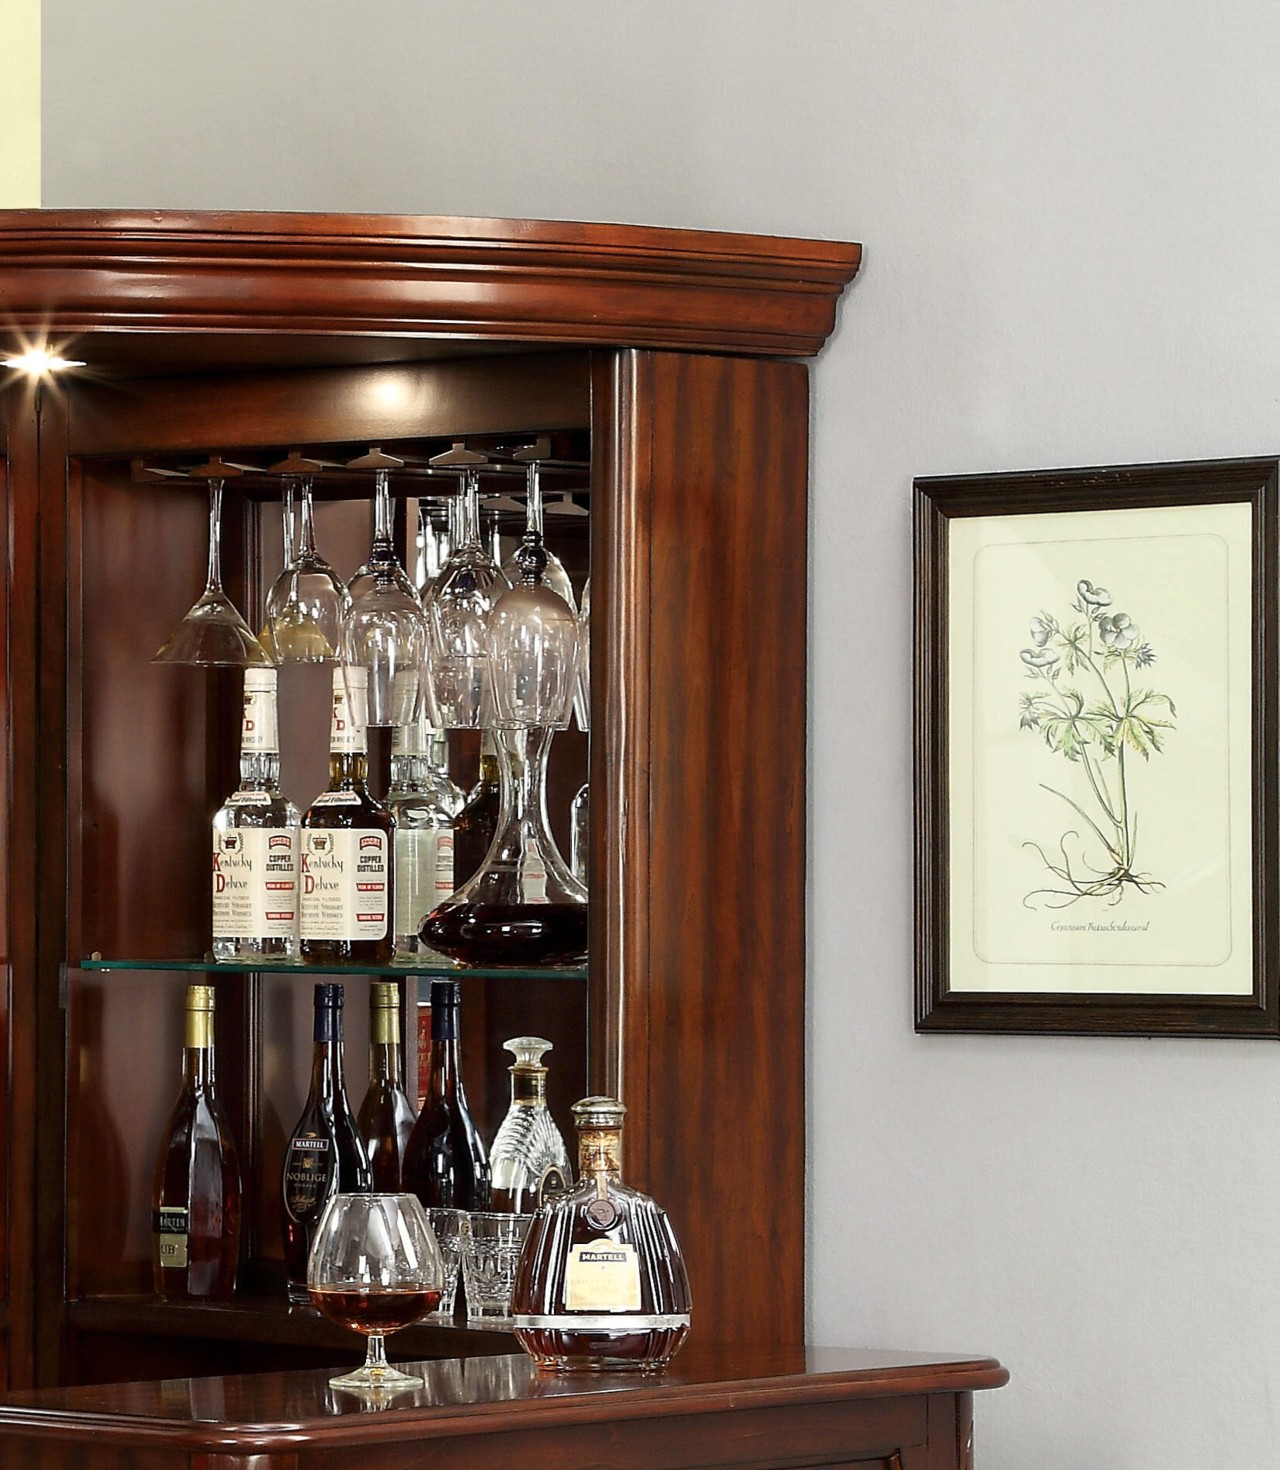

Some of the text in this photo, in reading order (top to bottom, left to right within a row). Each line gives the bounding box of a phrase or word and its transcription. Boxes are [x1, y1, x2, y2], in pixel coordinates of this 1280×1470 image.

[213, 853, 252, 871] Kentucky
[301, 854, 344, 873] Kentucky
[216, 874, 248, 893] Deluxe
[304, 875, 339, 894] Deluxe
[295, 1140, 324, 1149] MARTELL
[286, 1172, 327, 1182] NOBLIGE
[582, 1253, 625, 1261] MARTELL
